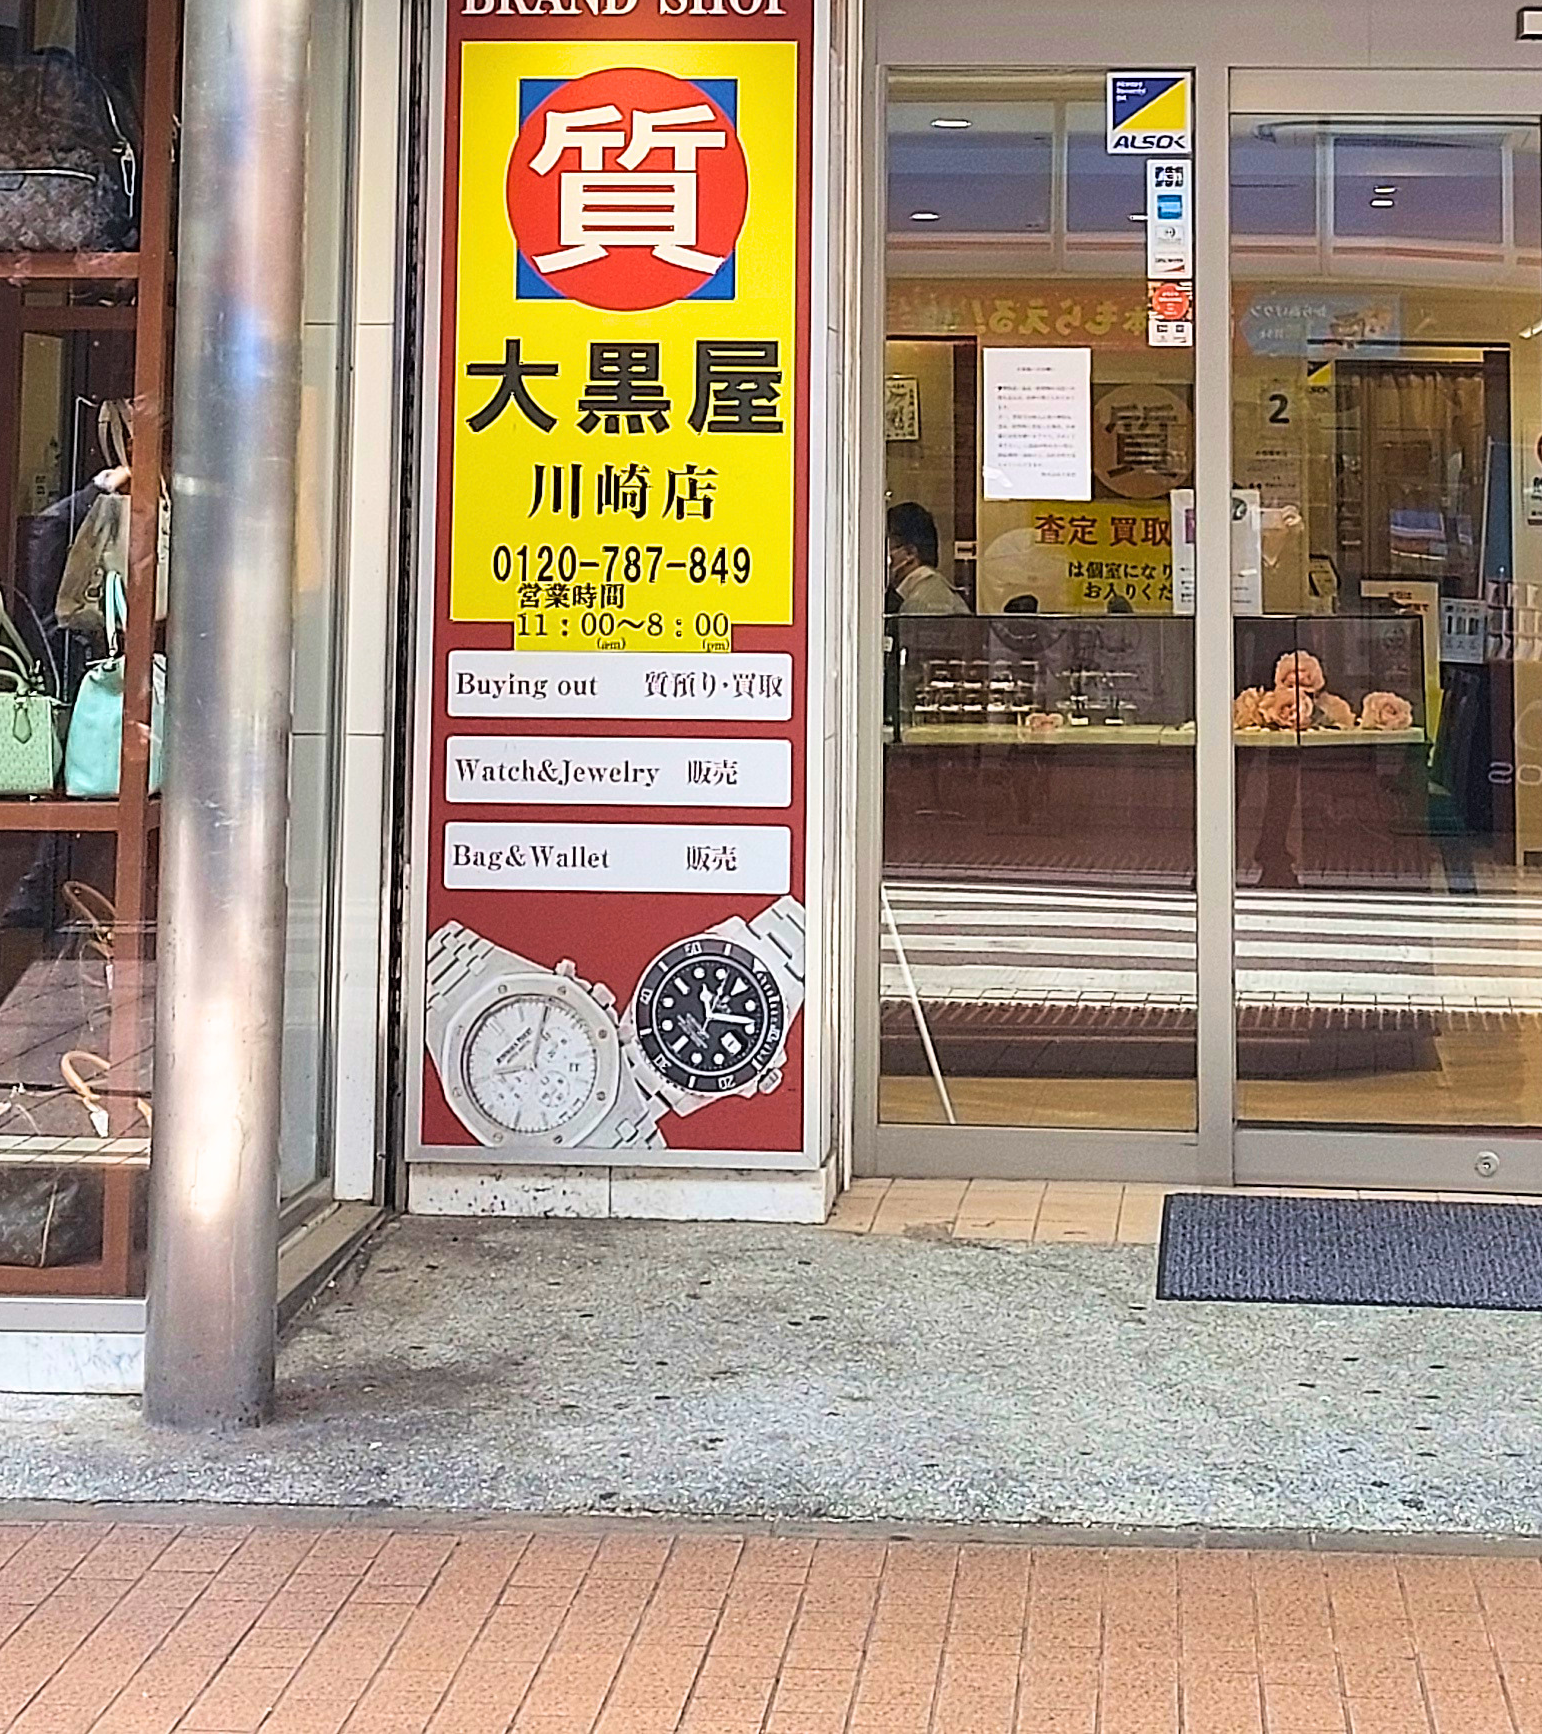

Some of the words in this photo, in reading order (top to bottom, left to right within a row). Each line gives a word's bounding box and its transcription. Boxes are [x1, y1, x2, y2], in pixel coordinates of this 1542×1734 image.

[1113, 135, 1186, 149] ALSOK
[530, 105, 725, 274] 質
[466, 339, 783, 435] 大黒屋
[1269, 394, 1290, 424] 2
[528, 464, 719, 520] 川崎店
[1034, 514, 1098, 546] 査定
[493, 546, 751, 583] 0120-787-849
[518, 584, 625, 609] 営業時間
[456, 672, 548, 698] Buying
[558, 674, 598, 696] out
[456, 758, 660, 787] Watch&Jewelry
[687, 760, 738, 786] 販売
[453, 844, 609, 871] Bag&Wallet
[686, 845, 738, 872] 販売
